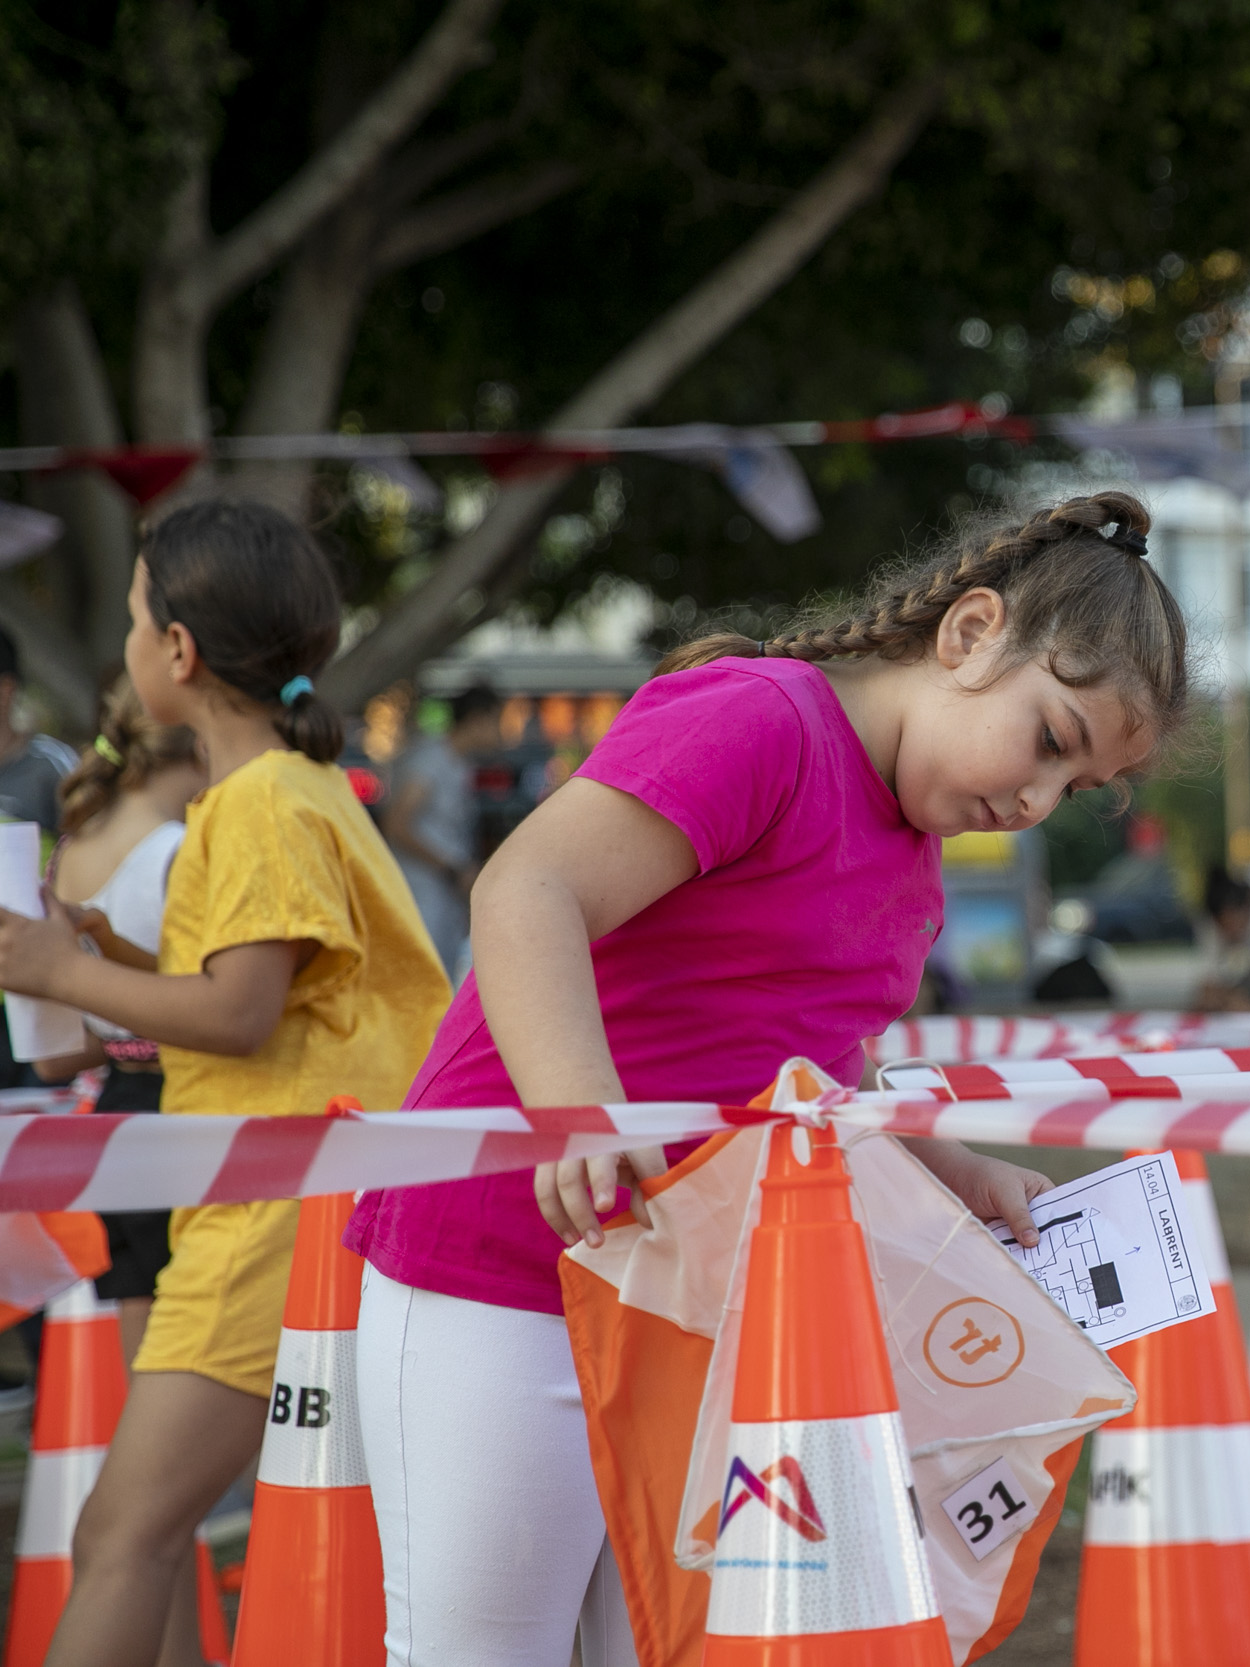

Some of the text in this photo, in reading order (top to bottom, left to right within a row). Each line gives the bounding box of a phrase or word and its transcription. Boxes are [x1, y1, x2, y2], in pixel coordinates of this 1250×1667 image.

[1143, 1166, 1160, 1195] 14.04
[1158, 1209, 1184, 1270] LABRENT
[957, 1480, 1027, 1544] 31
